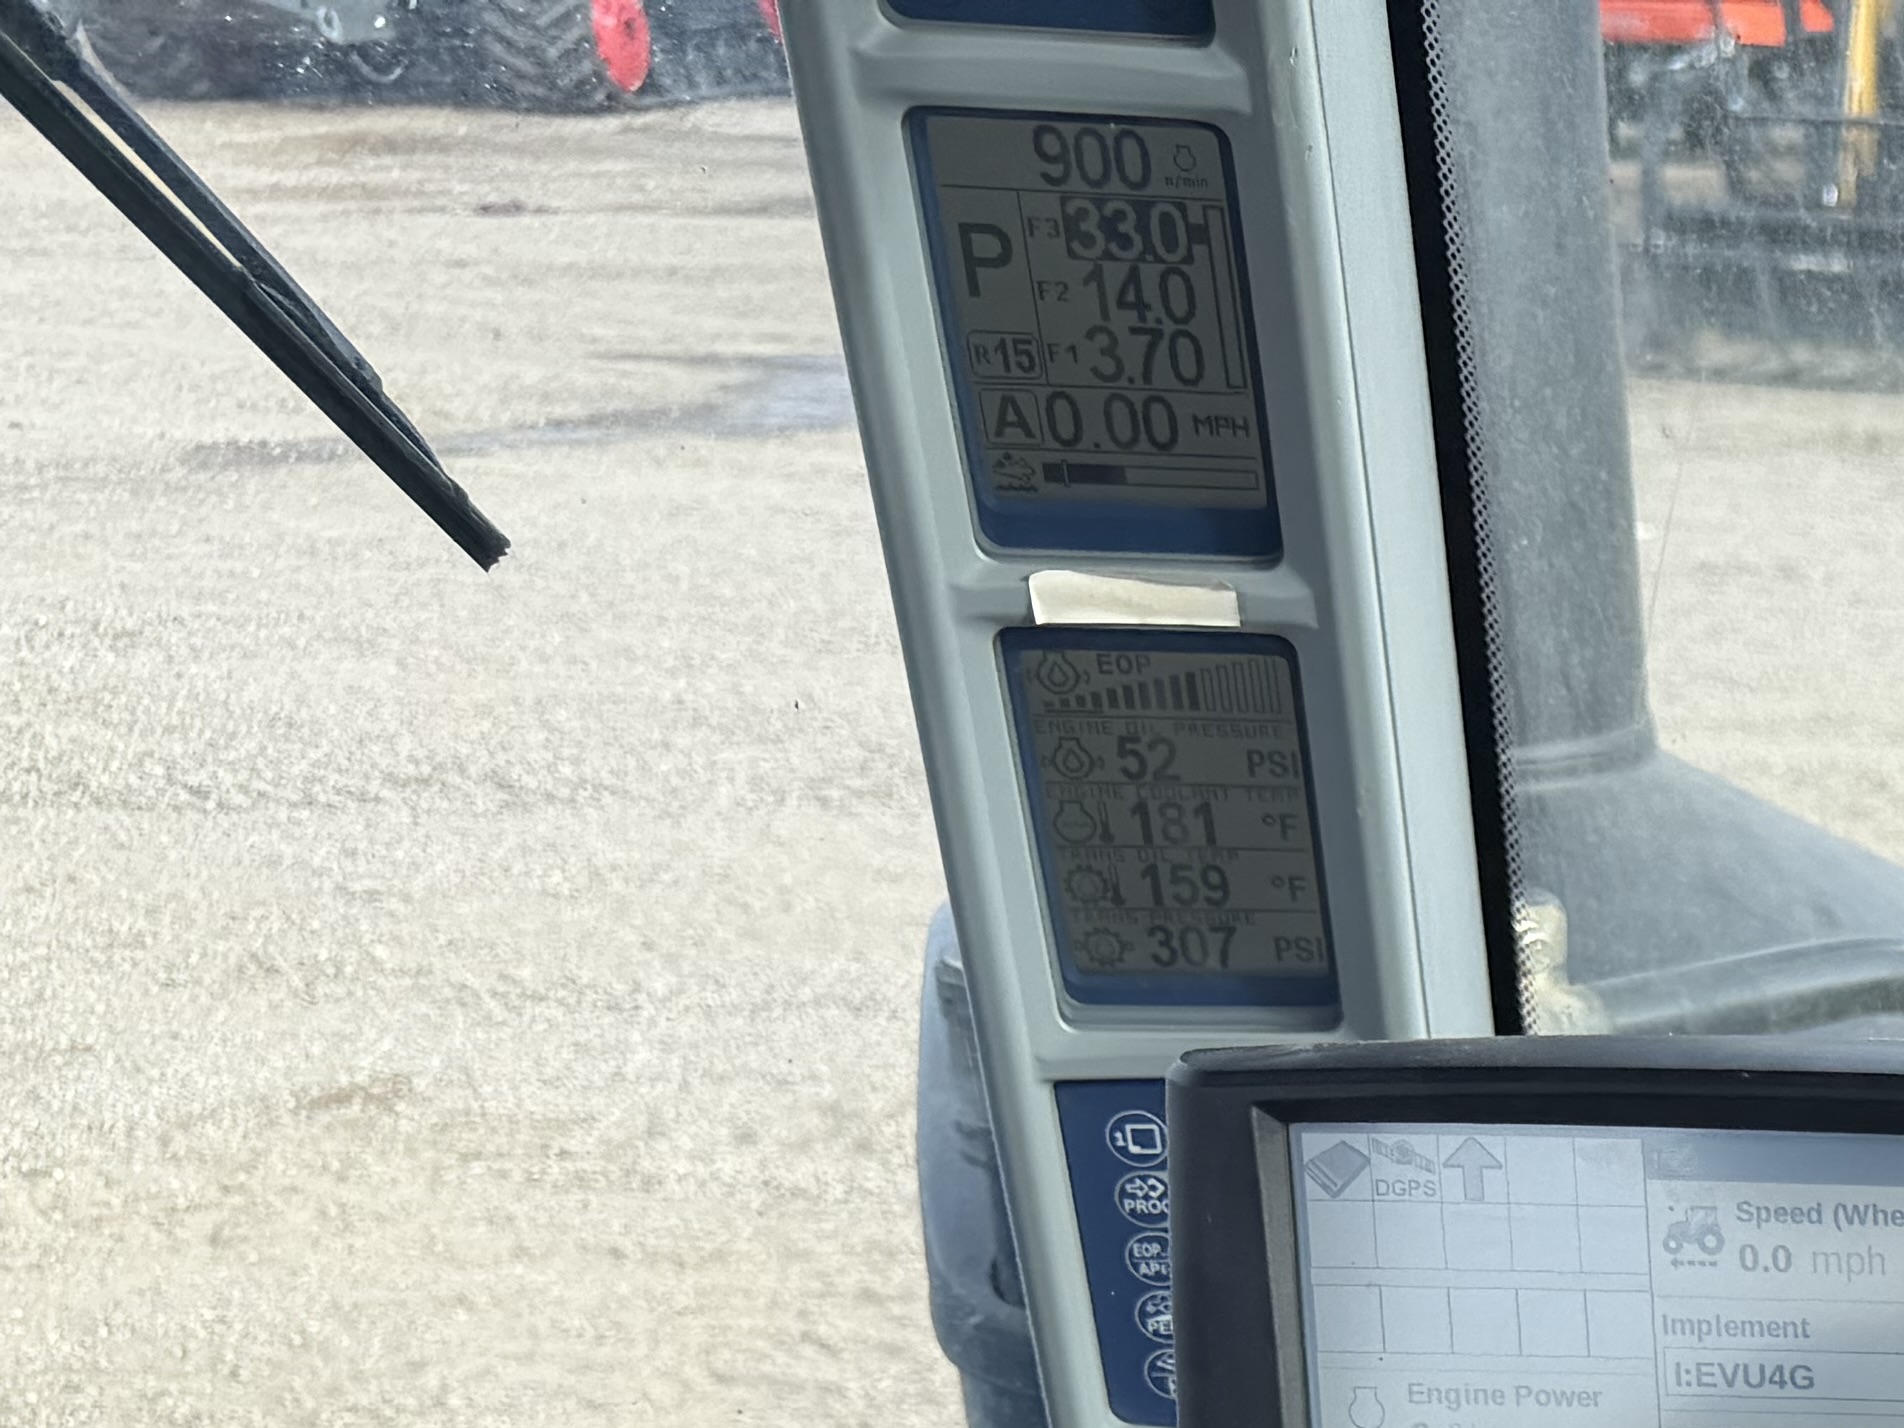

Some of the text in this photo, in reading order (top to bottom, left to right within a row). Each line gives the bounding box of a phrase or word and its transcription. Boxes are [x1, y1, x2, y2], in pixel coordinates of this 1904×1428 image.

[1033, 124, 1151, 191] 900
[1027, 200, 1190, 261] F3 33.0
[958, 222, 1013, 297] P
[1037, 264, 1197, 324] F2 14.0
[1048, 325, 1206, 386] F1 3.70
[994, 391, 1250, 452] A 0.00 MPH
[1097, 653, 1151, 675] EOP
[1034, 719, 1284, 739] ENGINE OIL PRESSURE
[1116, 736, 1300, 782] 52 PSI
[1130, 802, 1299, 846] 181 °F
[1140, 863, 1307, 908] 159 °F
[1145, 925, 1325, 969] 307 PSI
[1375, 1179, 1437, 1198] DGPS
[1735, 1201, 1823, 1229] Speed
[1738, 1244, 1888, 1283] 0.0 mph
[1662, 1314, 1811, 1343] Implement
[1407, 1382, 1603, 1412] Engine Power
[1674, 1363, 1816, 1392] I:EVU4G
